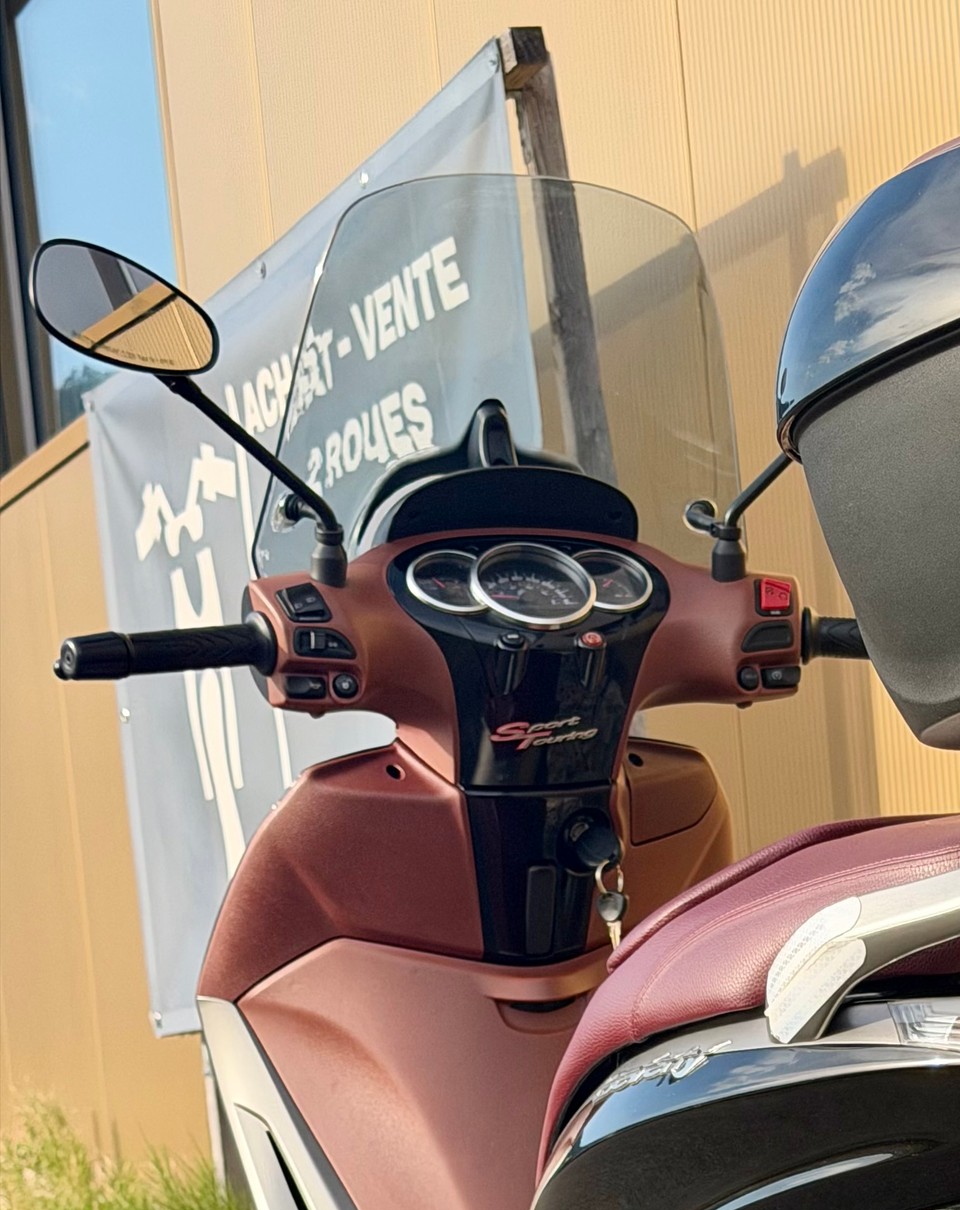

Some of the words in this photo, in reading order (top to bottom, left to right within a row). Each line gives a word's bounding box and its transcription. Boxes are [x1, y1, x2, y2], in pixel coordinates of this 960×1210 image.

[350, 236, 470, 361] VENTE
[306, 447, 323, 497] 2
[325, 382, 434, 488] ROUES
[490, 716, 581, 742] Sport
[516, 728, 599, 750] Touring
